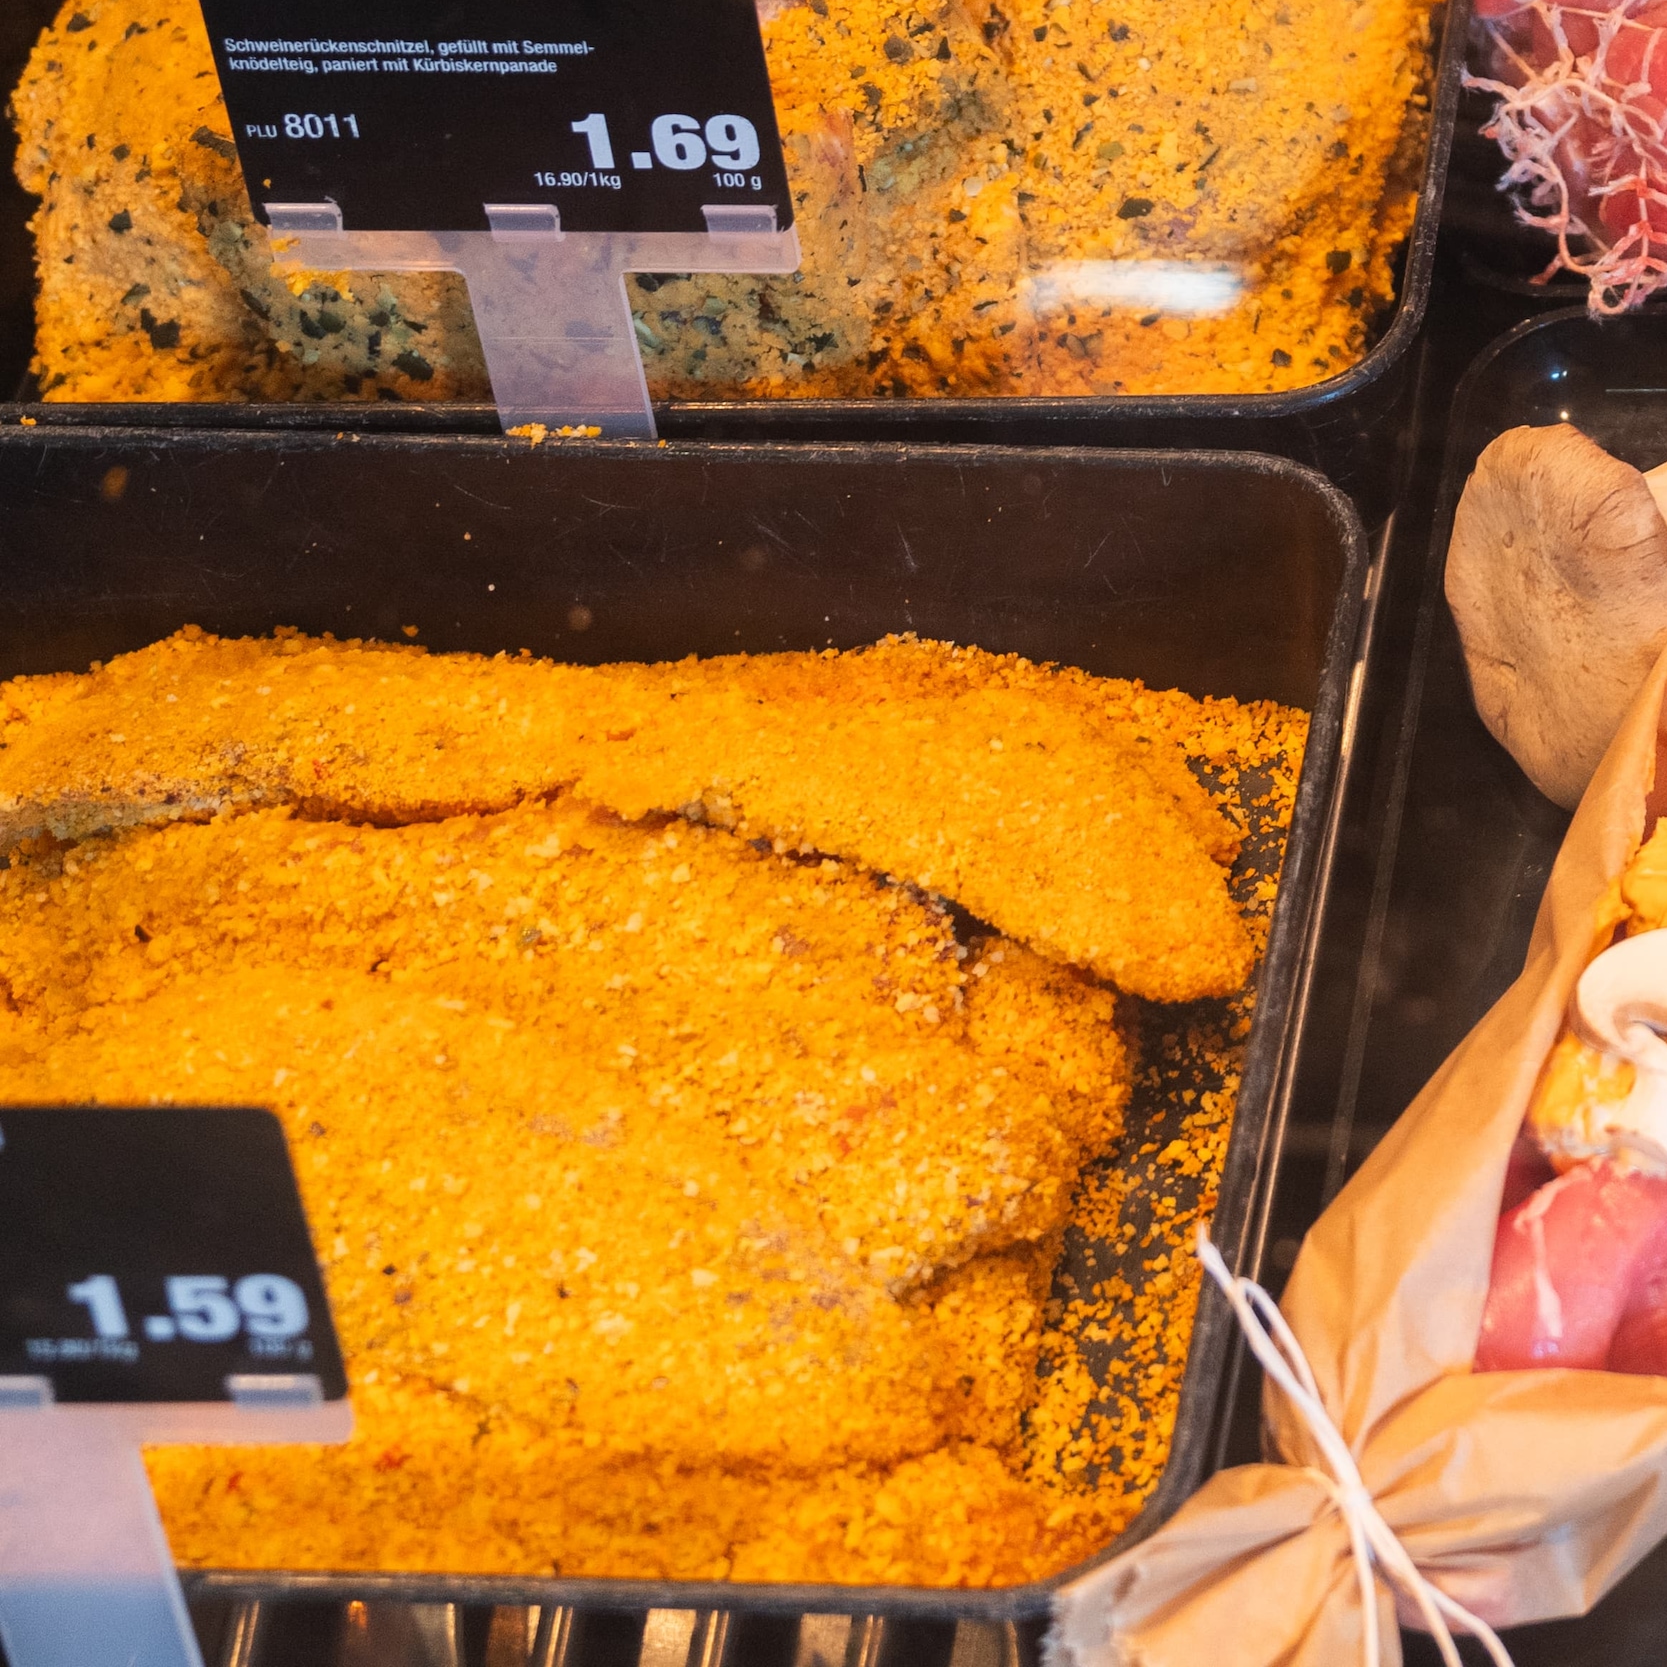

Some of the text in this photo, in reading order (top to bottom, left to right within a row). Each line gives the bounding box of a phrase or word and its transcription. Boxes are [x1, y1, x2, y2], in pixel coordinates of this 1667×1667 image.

[224, 38, 595, 56] Schweinerückenschnitzel, gefüllt mit Semmel-
[229, 57, 557, 74] knödelteig, paniert mit Kürbiskernpanade
[246, 113, 360, 139] PLU 8011
[570, 113, 761, 170] 1.69
[534, 172, 621, 190] 16.90/1kg
[712, 172, 746, 188] 100
[67, 1273, 310, 1342] 1.59
